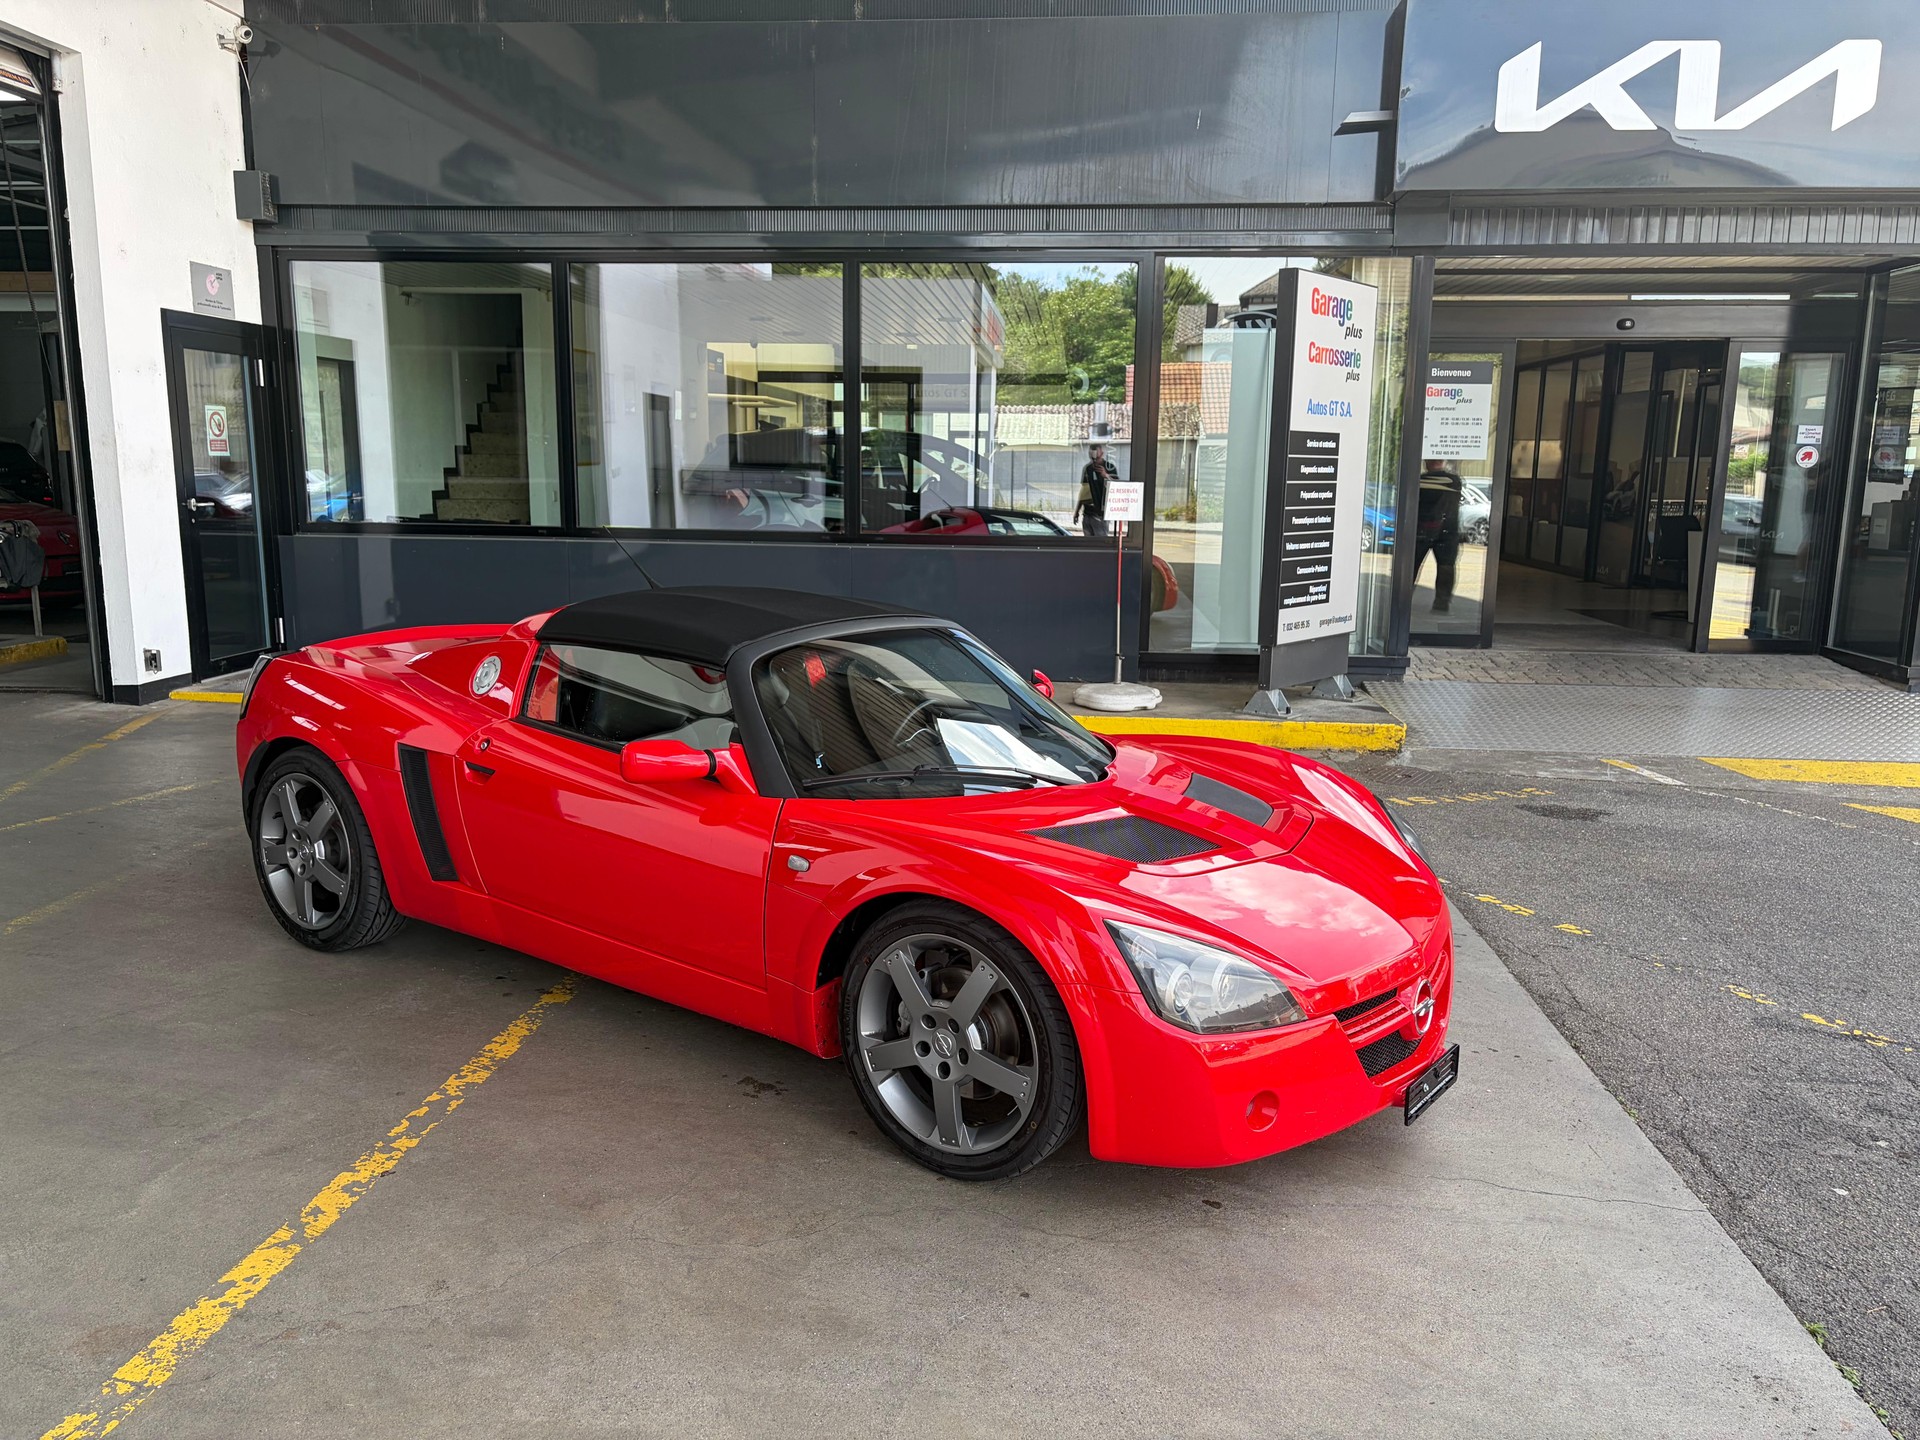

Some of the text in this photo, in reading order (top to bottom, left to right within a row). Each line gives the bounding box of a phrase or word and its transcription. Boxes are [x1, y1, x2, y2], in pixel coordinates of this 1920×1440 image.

[1494, 38, 1883, 133] KIA
[1311, 287, 1353, 327] Garage
[1344, 323, 1363, 339] plus
[1308, 341, 1361, 369] Carrosserie
[1345, 370, 1360, 382] plus
[1431, 367, 1472, 377] Bienvenue
[1426, 386, 1463, 400] Garage
[1456, 397, 1472, 405] plus
[1307, 398, 1353, 417] Autos GT S.A.
